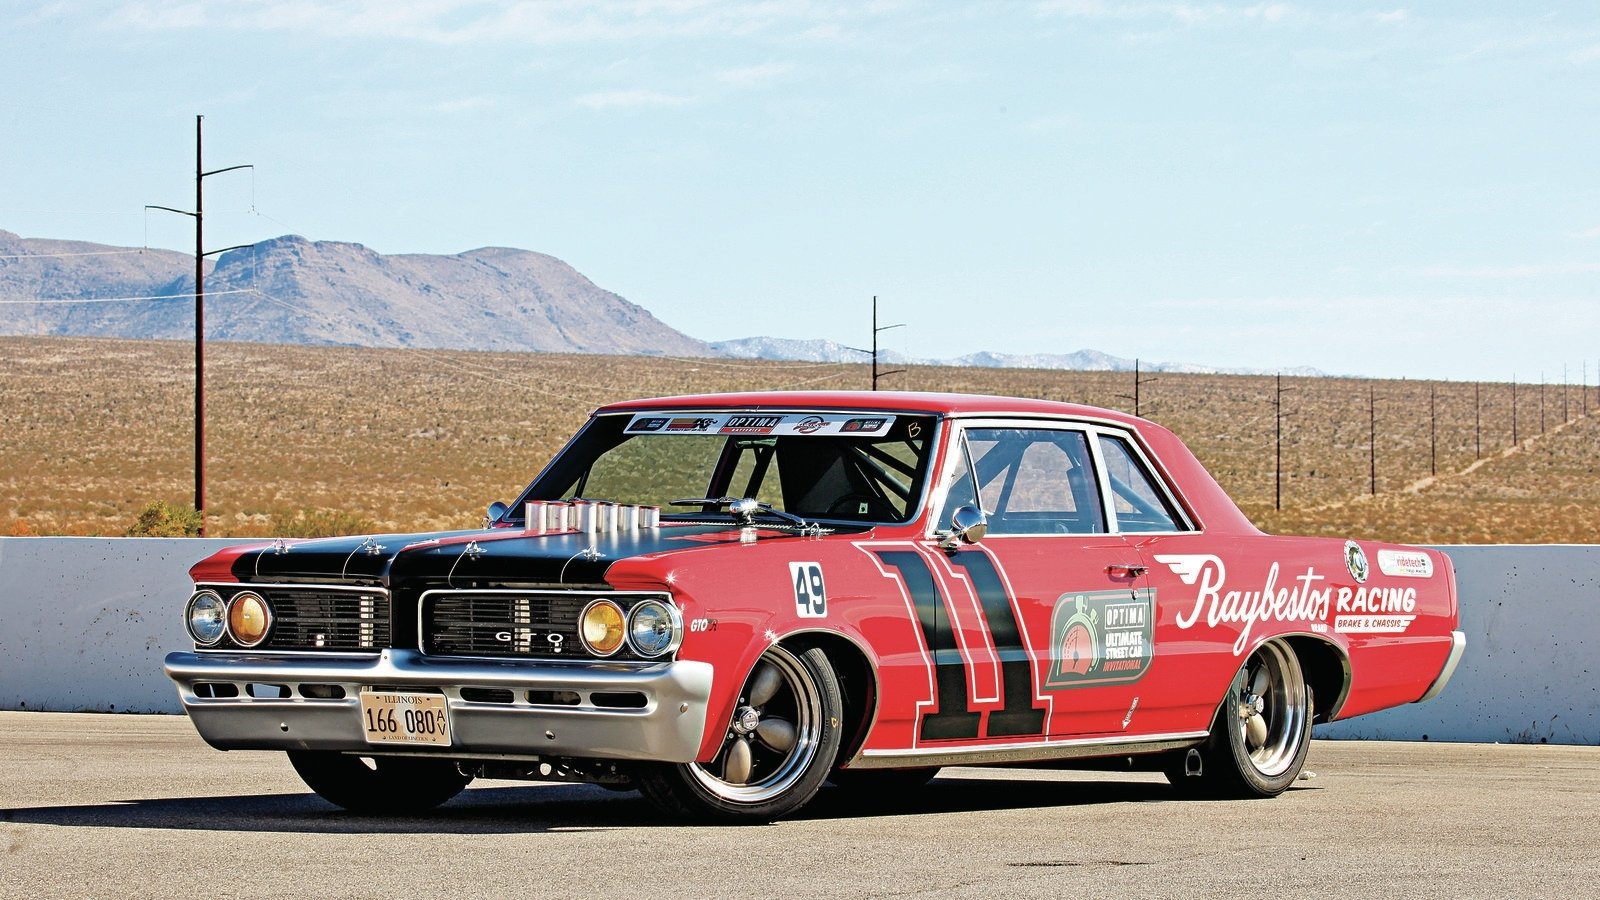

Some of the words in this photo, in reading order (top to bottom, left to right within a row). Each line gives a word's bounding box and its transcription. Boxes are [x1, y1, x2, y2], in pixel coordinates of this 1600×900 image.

[727, 417, 778, 427] OPTIMA
[796, 566, 825, 614] 49
[1172, 554, 1331, 656] Raybestos
[1336, 586, 1417, 613] RACING
[1106, 607, 1143, 626] OPTIMA
[1337, 619, 1362, 628] BRAKE
[1364, 619, 1369, 628] &
[1371, 619, 1402, 628] CHASSIS
[691, 618, 708, 632] GTO
[495, 631, 564, 643] GTO
[1105, 632, 1143, 647] ULTIMATE
[873, 551, 1046, 740] 11
[1105, 647, 1129, 660] STREET
[1129, 646, 1143, 658] CAR
[1103, 660, 1142, 672] INVITATIONAL
[384, 695, 423, 705] ILLINOIS
[366, 708, 397, 733] 166
[404, 709, 436, 734] 080
